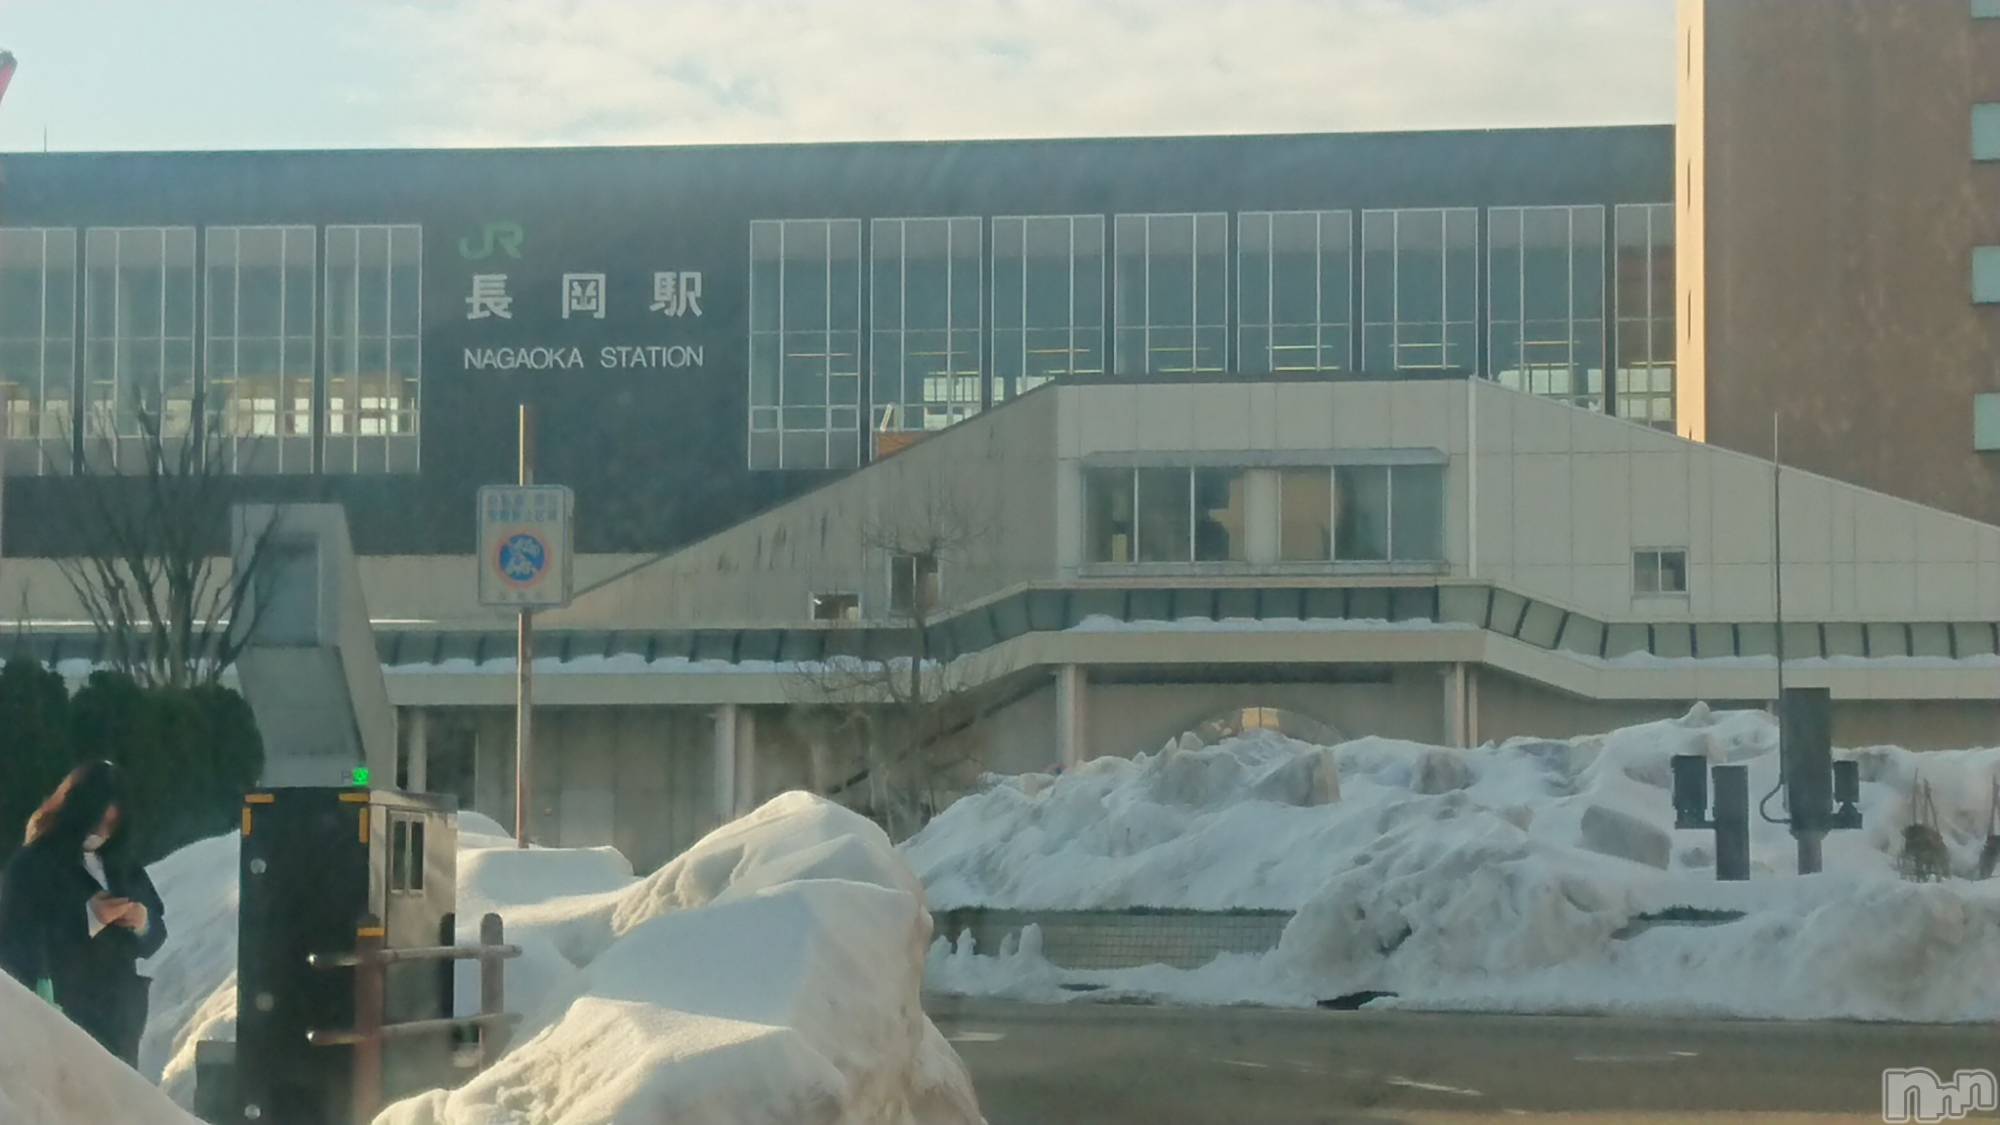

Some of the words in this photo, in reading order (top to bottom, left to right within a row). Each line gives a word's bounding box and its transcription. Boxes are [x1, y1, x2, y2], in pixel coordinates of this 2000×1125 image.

[458, 221, 524, 260] JR
[465, 271, 702, 319] 長岡駅
[464, 347, 584, 369] NAGAOKA
[600, 345, 704, 368] STATION
